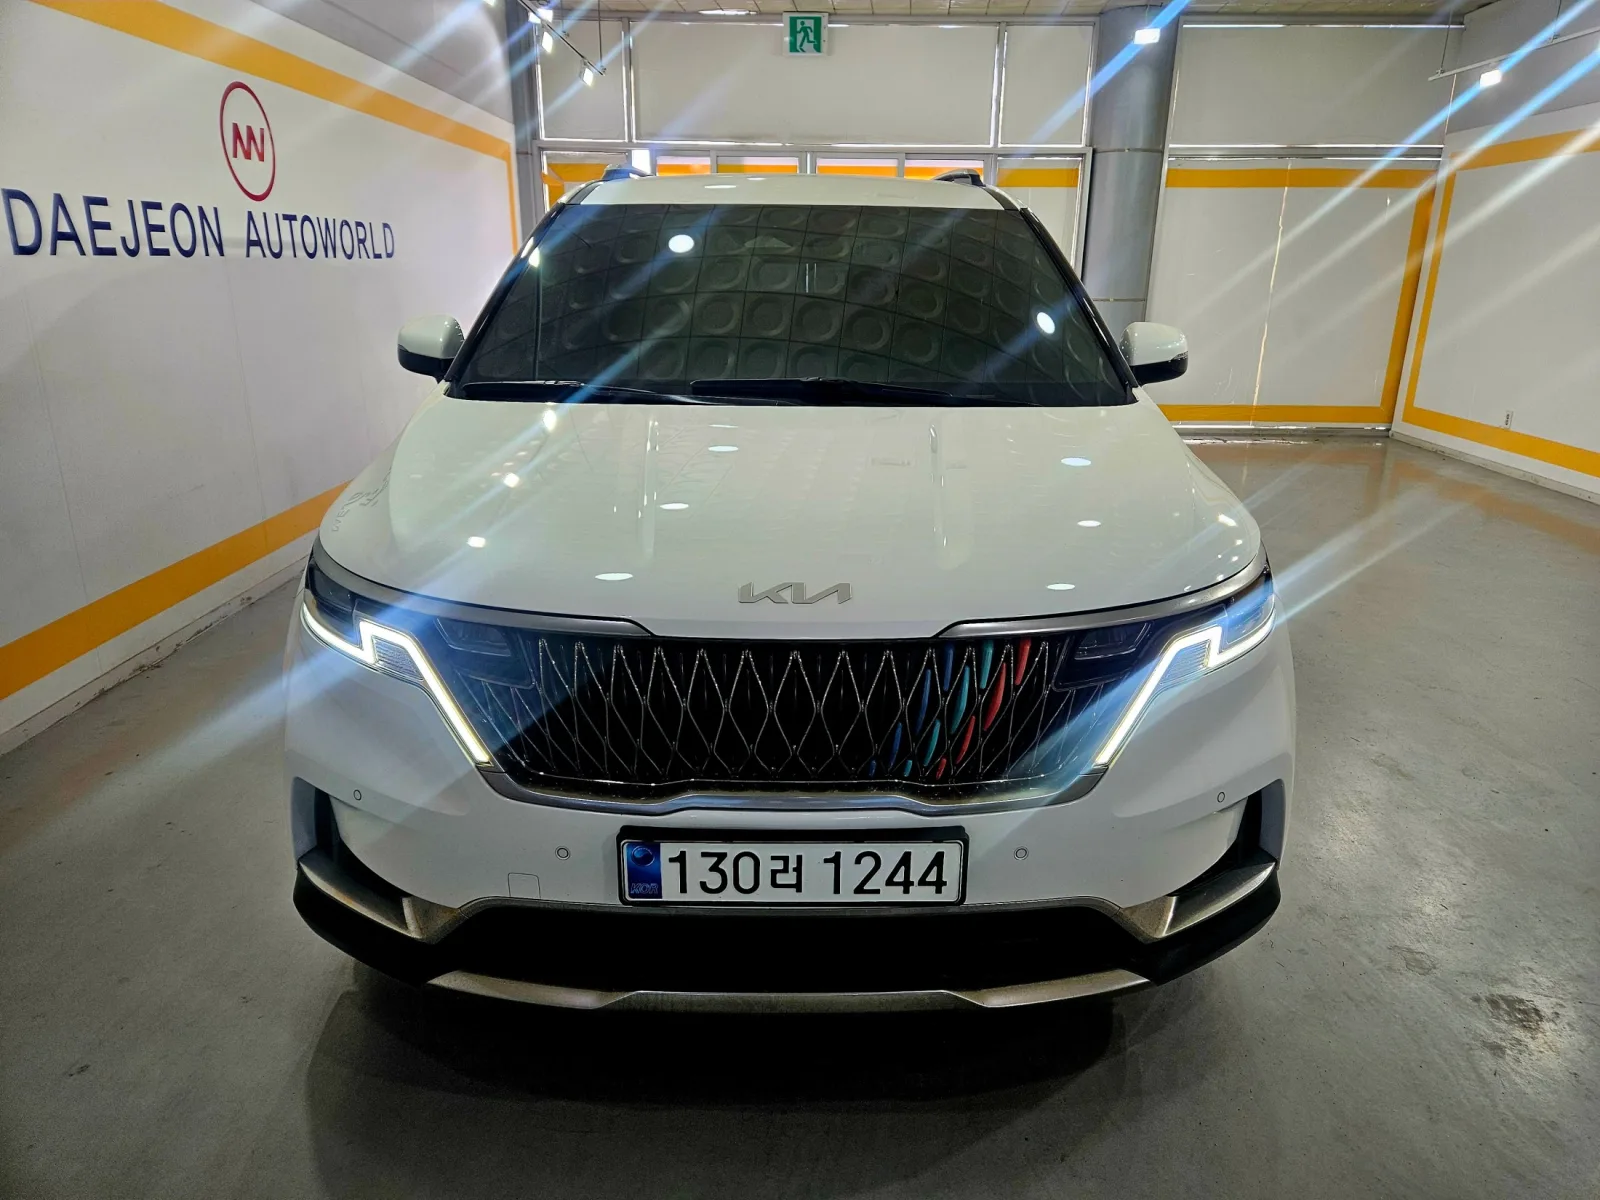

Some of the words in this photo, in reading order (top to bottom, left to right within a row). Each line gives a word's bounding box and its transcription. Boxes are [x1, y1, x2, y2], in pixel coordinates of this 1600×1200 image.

[1, 187, 225, 257] DAEJEON
[245, 210, 395, 259] AUTOWORLD
[738, 581, 852, 604] KIA
[630, 882, 659, 895] KOR
[668, 850, 803, 894] 130러
[823, 850, 948, 894] 1244
